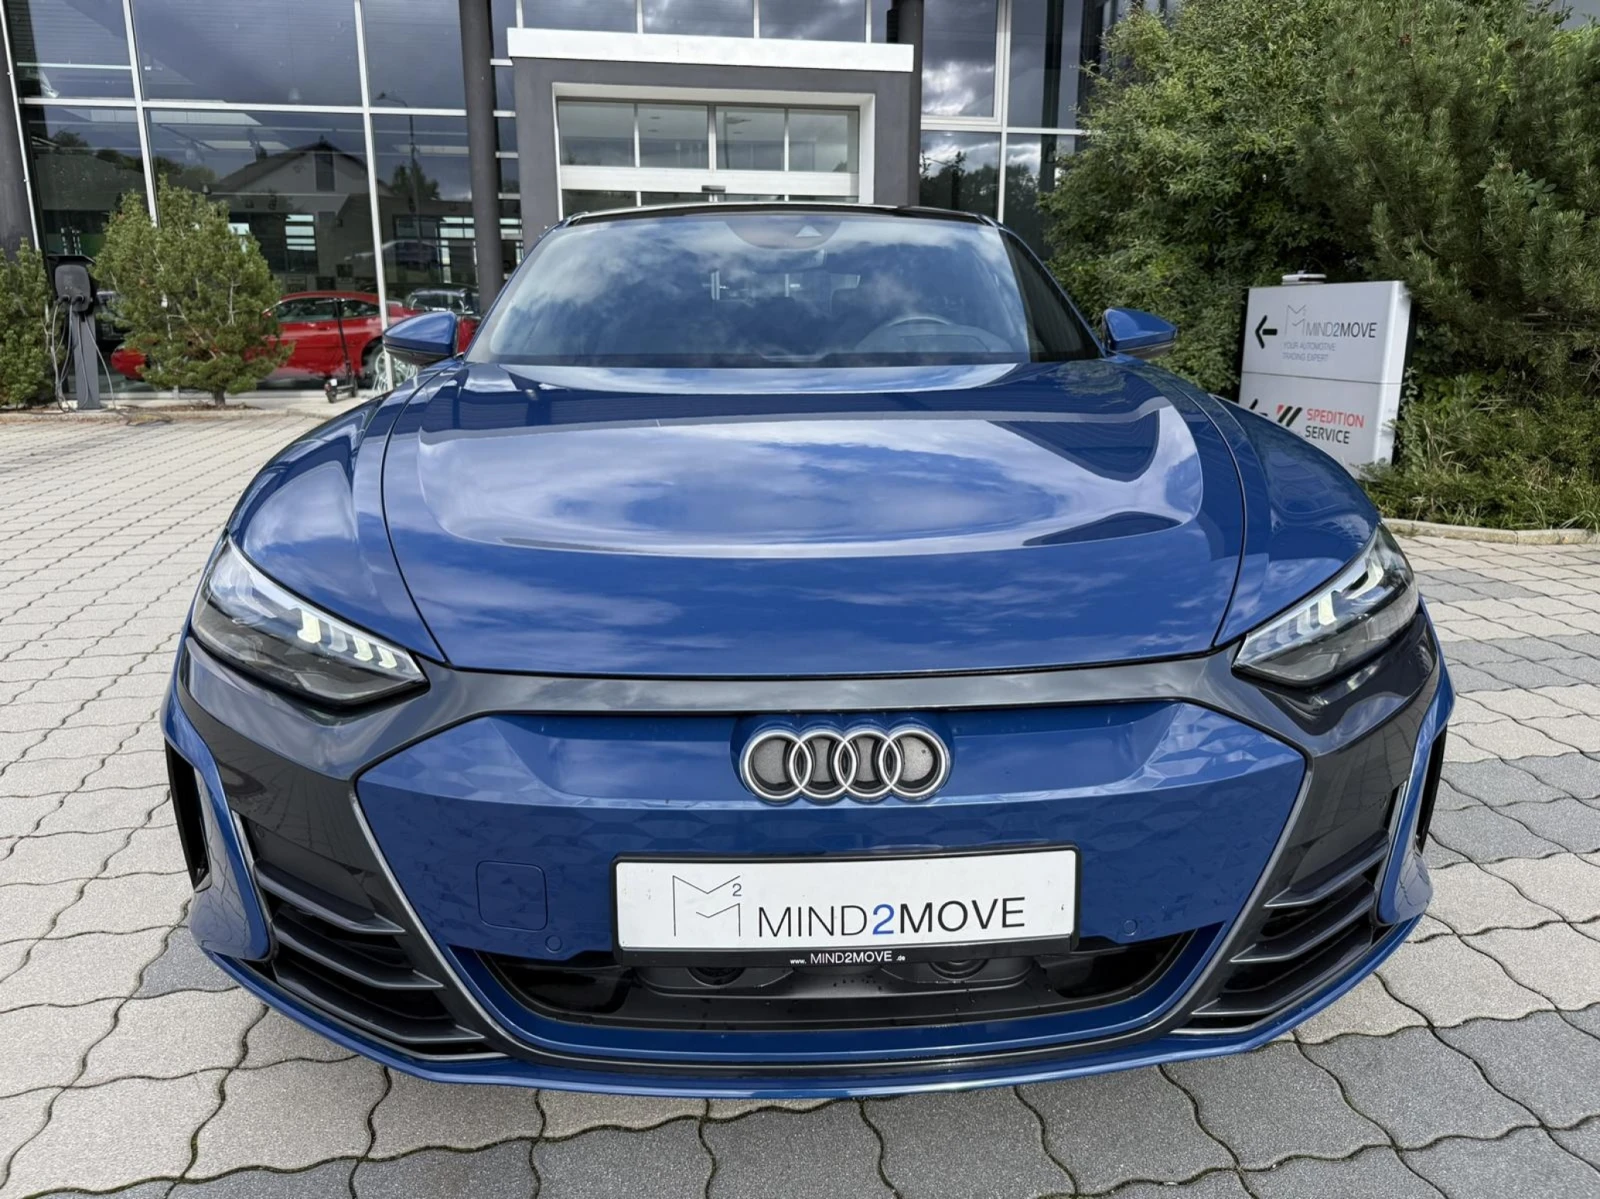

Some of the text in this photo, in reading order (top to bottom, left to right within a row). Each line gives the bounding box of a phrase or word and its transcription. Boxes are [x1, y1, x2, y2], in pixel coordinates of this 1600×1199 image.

[1306, 321, 1377, 338] MIND2MOVE
[1284, 341, 1336, 351] YOUR AUTOMOTIVE
[1306, 408, 1365, 429] SPEDITION
[1305, 425, 1350, 444] SERVICE
[759, 897, 1026, 937] MIND2MOVE
[810, 950, 892, 964] MIND2MOVE
